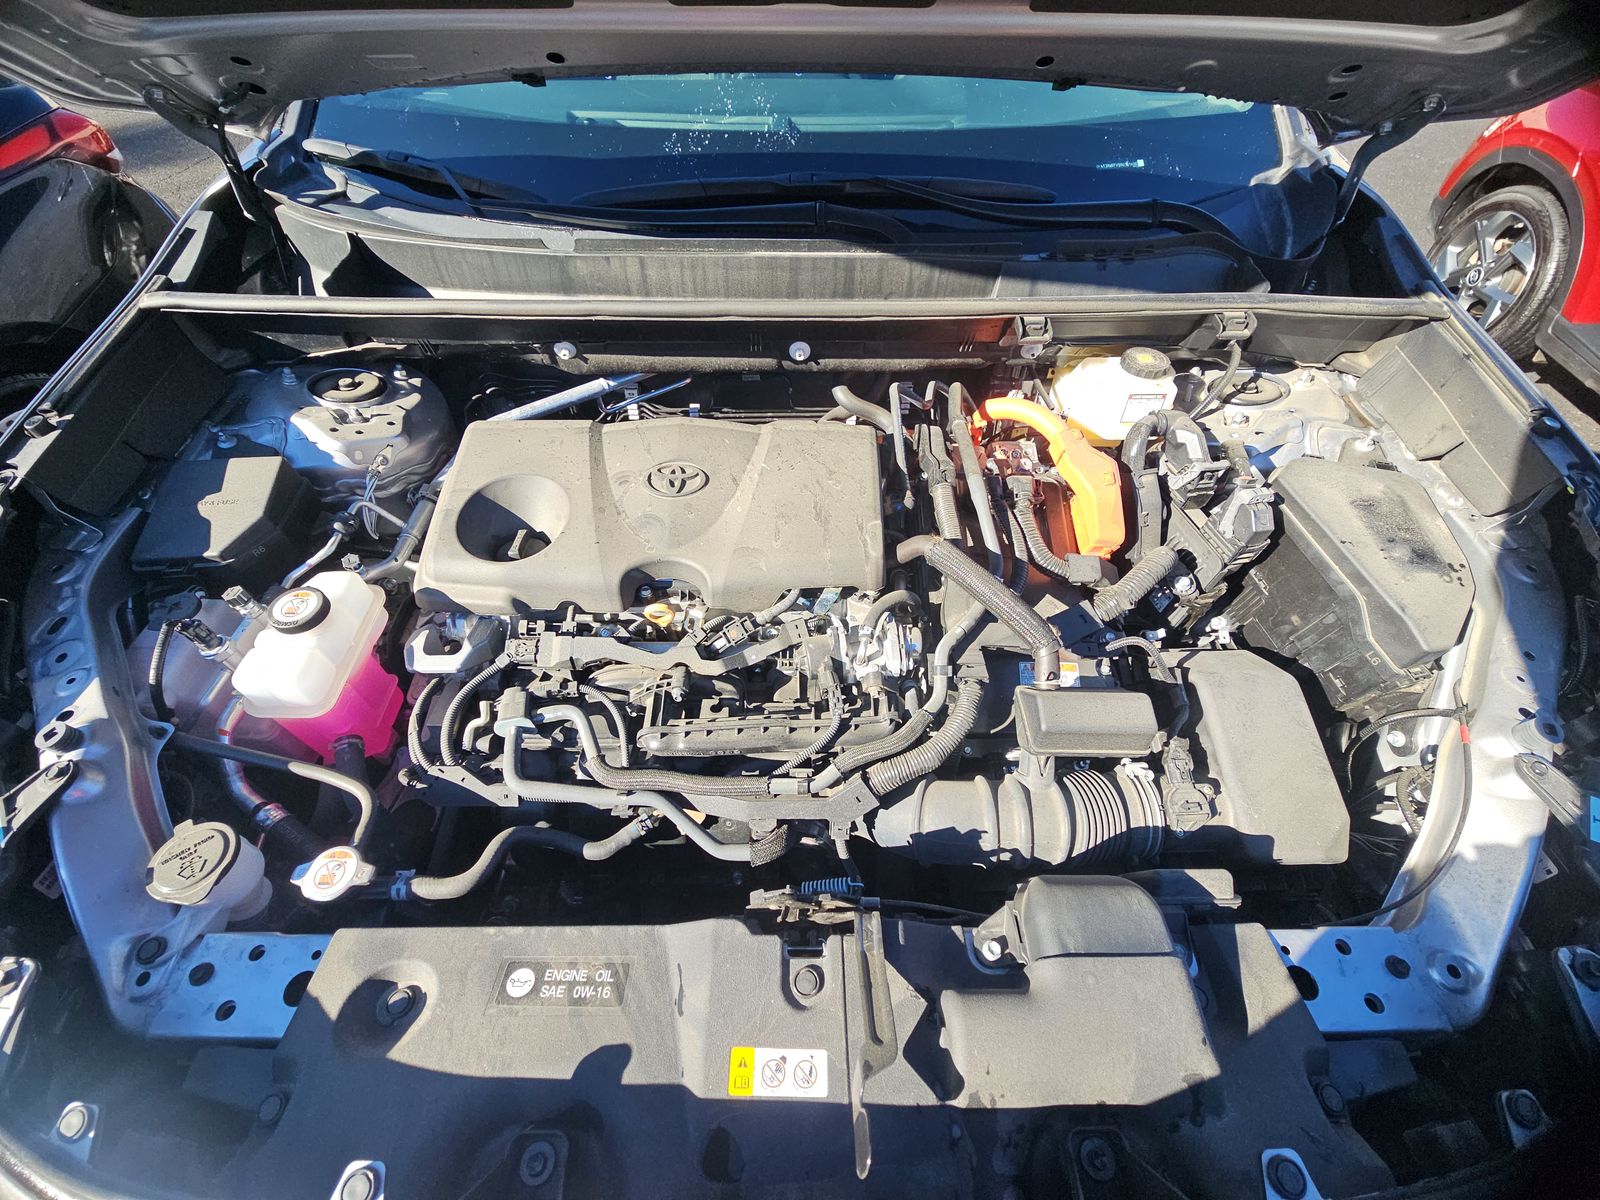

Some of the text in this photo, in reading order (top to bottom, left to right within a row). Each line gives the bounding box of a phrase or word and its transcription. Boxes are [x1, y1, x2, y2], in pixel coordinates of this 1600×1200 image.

[1366, 650, 1382, 665] L6
[544, 969, 614, 982] ENGINE OIL
[540, 985, 611, 999] SAE 0W-16
